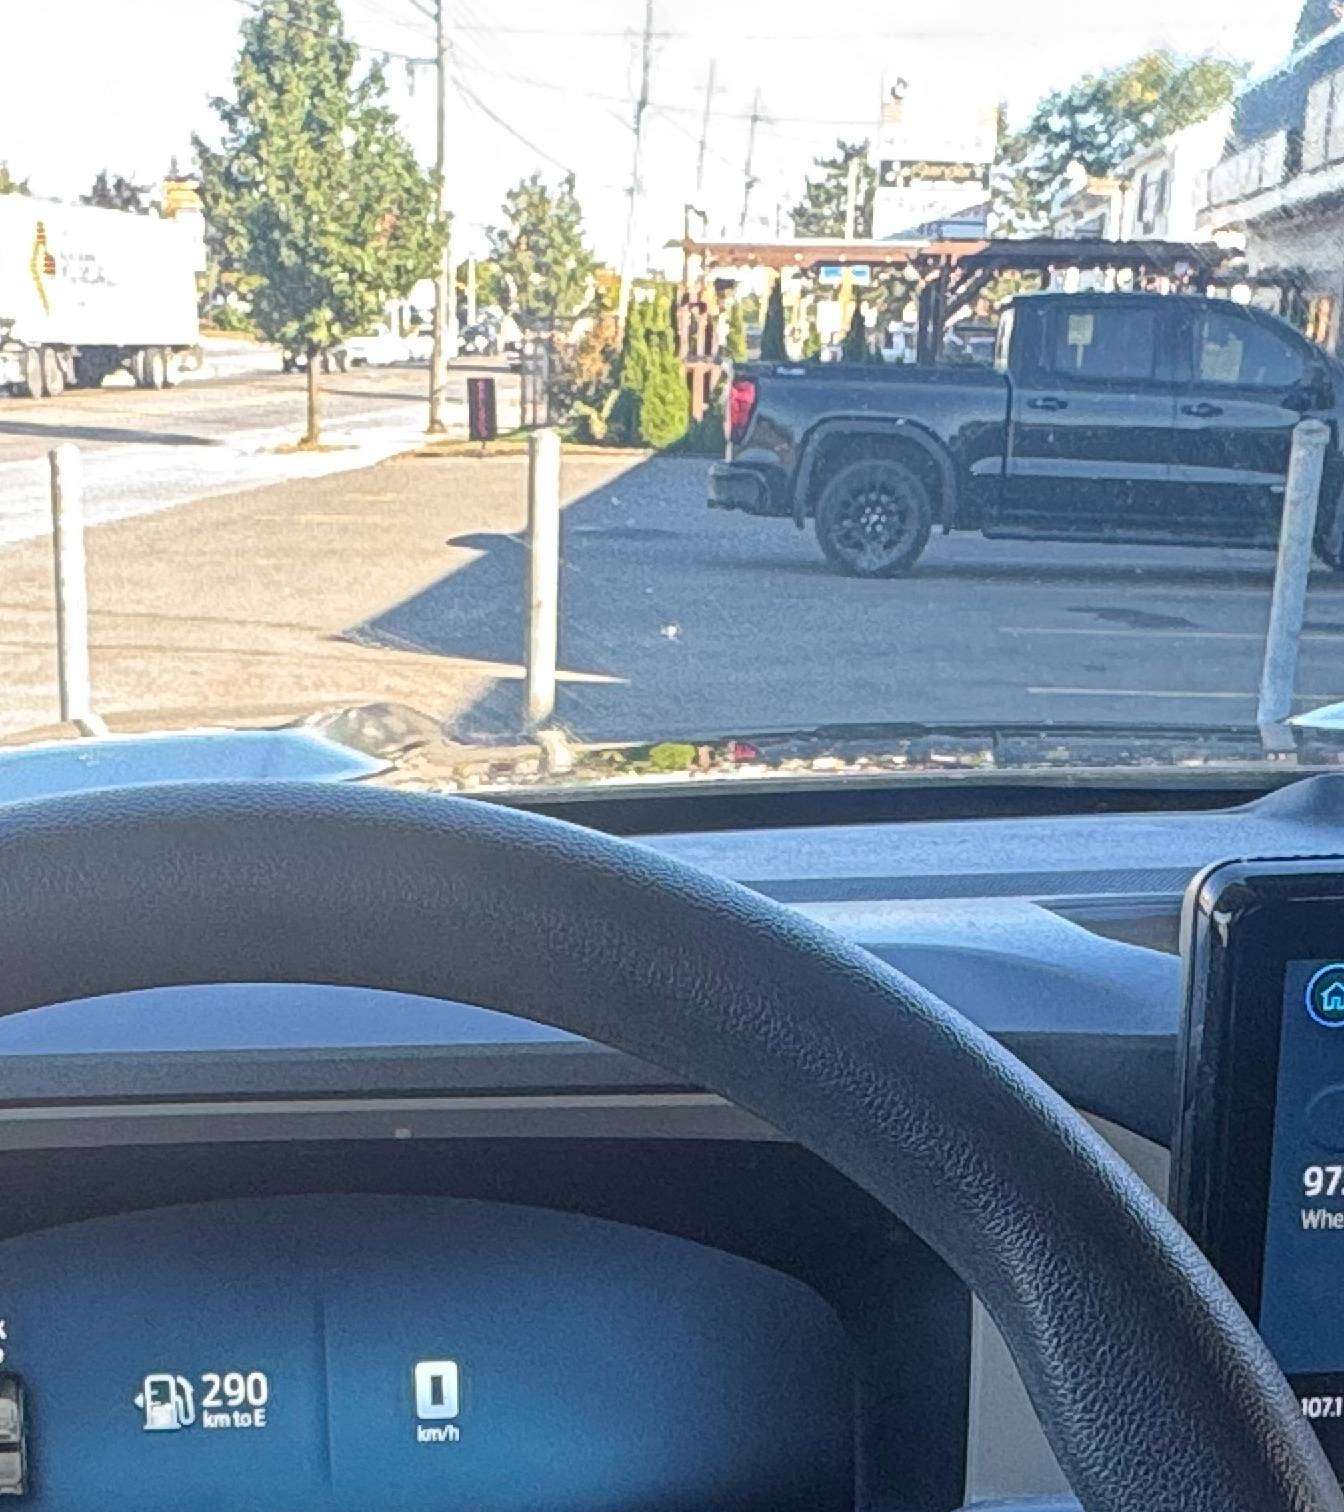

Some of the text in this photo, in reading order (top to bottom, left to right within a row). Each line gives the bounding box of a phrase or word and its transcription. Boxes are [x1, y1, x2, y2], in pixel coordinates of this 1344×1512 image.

[201, 1372, 267, 1407] 290
[415, 1360, 457, 1419] 0
[202, 1408, 266, 1428] km to E
[1301, 1397, 1343, 1418] 107.1
[417, 1424, 459, 1442] km/h
